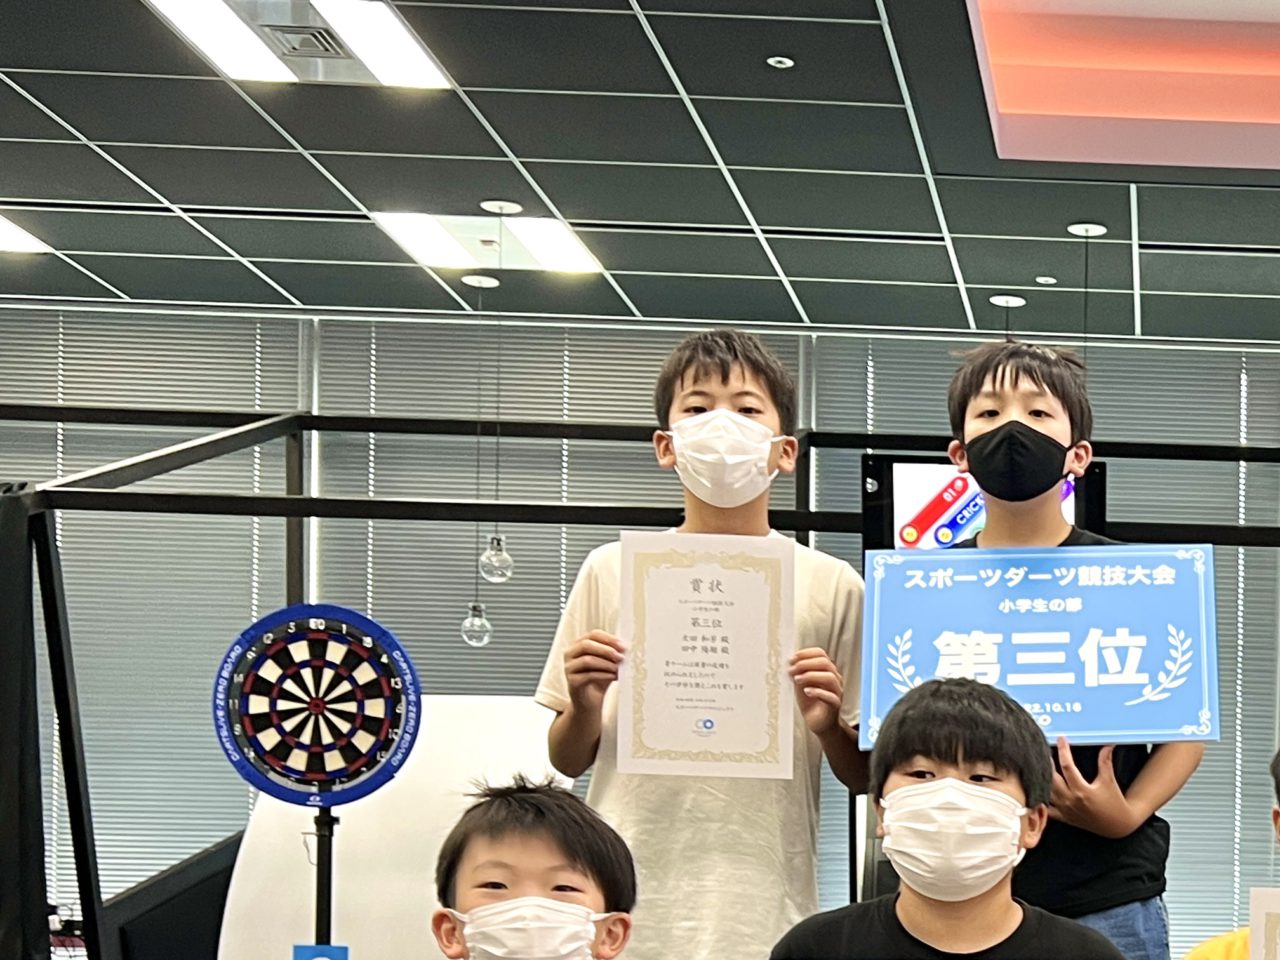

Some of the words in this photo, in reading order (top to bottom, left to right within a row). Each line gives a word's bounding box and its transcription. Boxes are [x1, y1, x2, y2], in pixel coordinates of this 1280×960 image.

[903, 565, 1176, 589] スポーツダーツ競技大会
[998, 598, 1083, 613] 小学生の部
[932, 627, 1150, 688] 第三位
